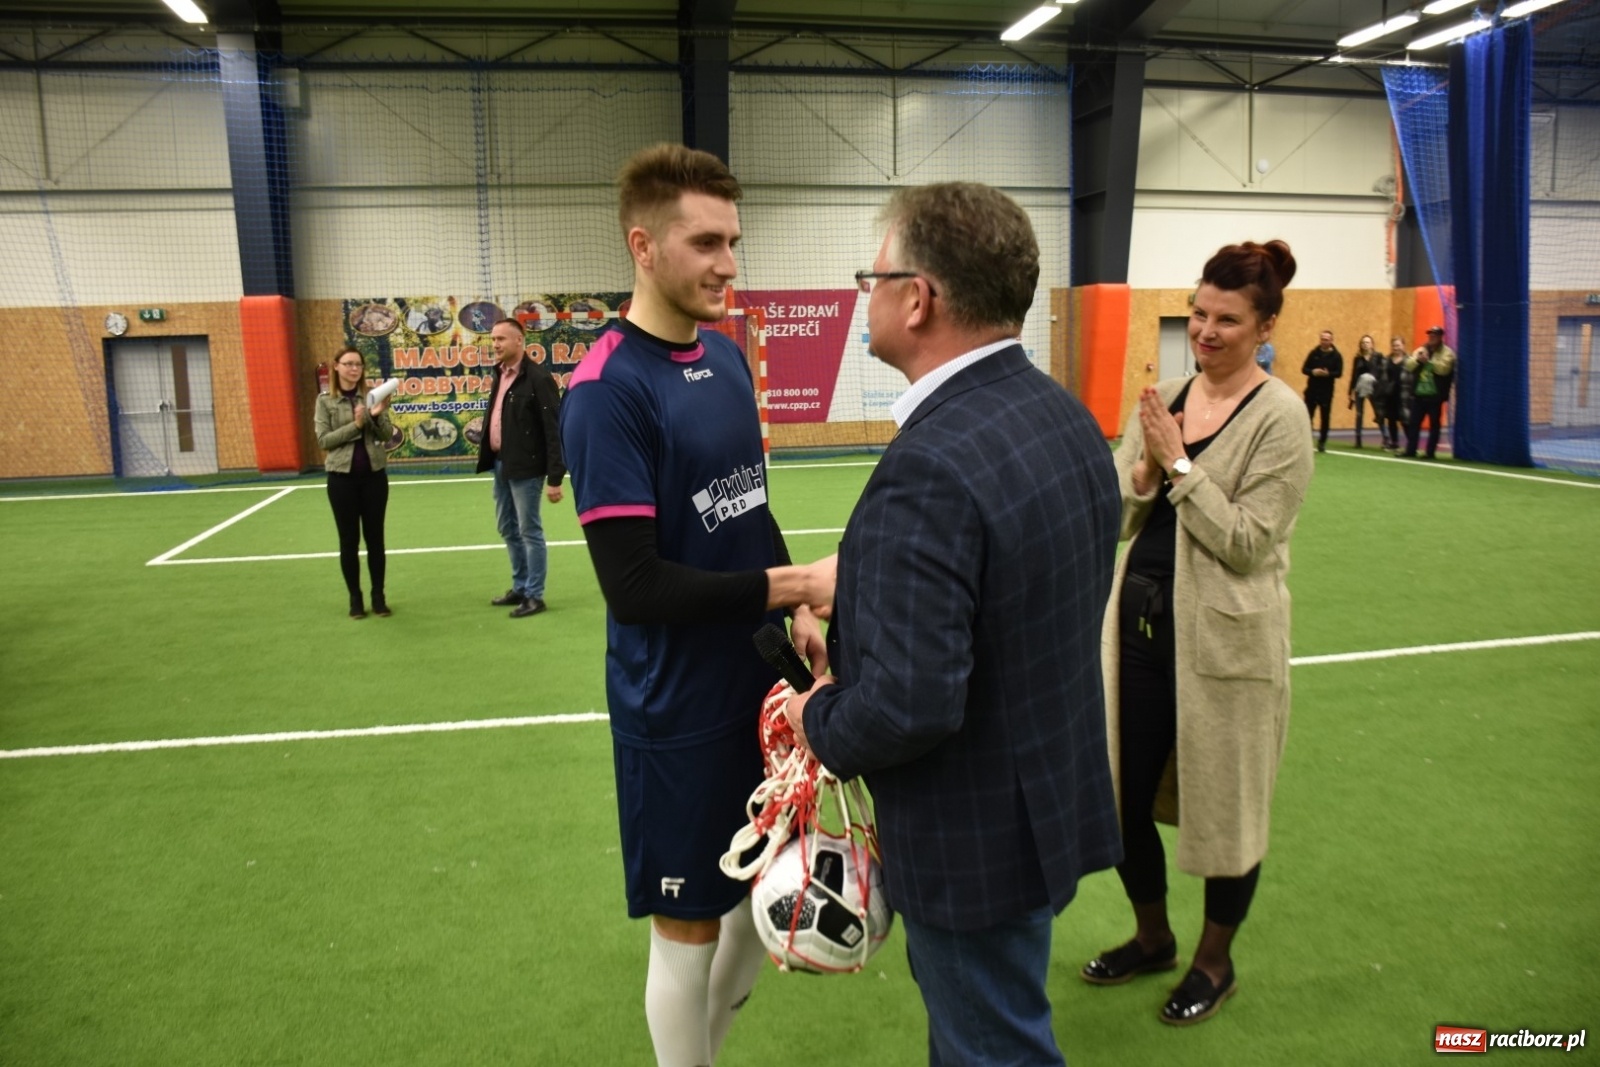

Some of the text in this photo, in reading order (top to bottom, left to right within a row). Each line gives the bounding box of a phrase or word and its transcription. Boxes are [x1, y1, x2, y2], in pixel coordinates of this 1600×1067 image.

[789, 301, 839, 318] ZDRAVÍ
[764, 320, 819, 337] BEZPEČÍ
[551, 342, 597, 365] RA
[783, 388, 801, 397] 800
[802, 387, 820, 396] 000
